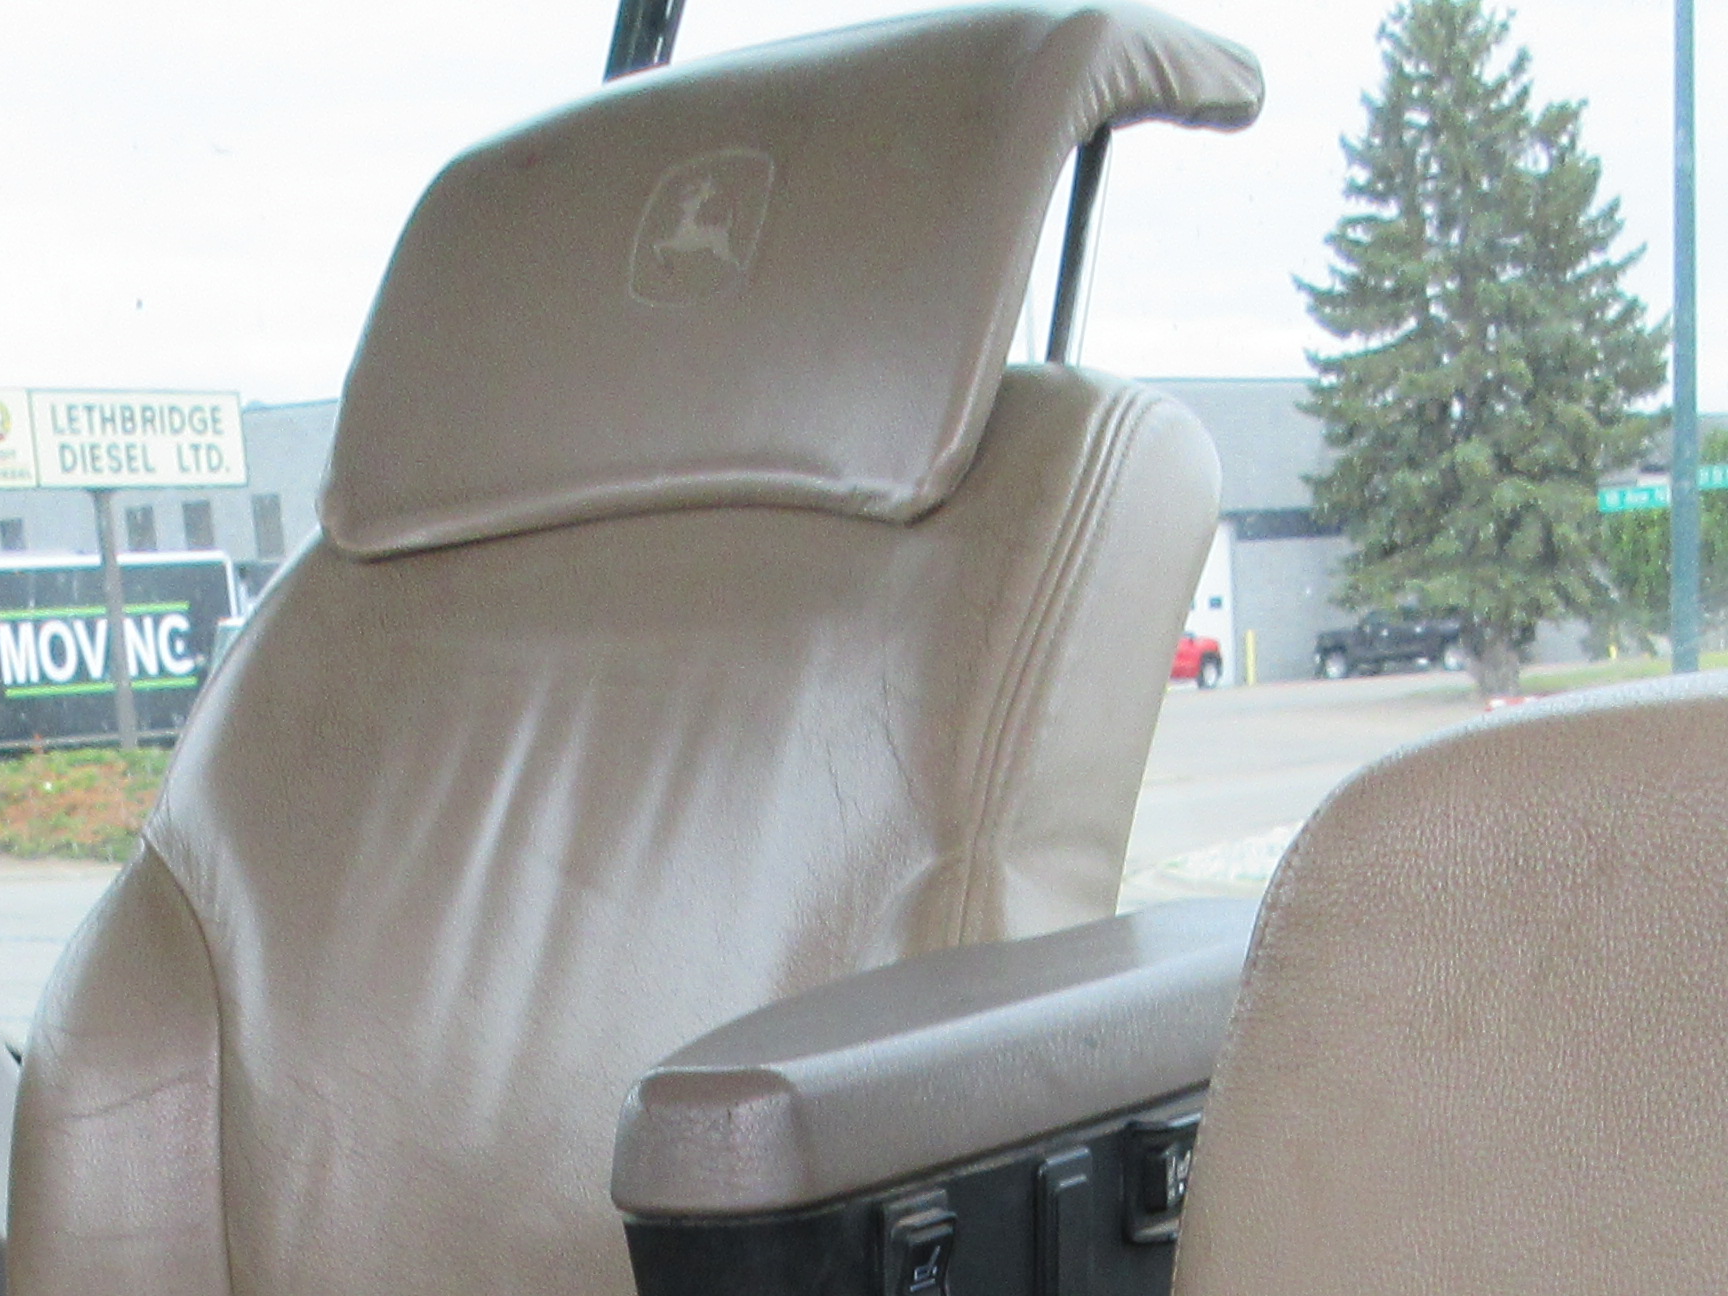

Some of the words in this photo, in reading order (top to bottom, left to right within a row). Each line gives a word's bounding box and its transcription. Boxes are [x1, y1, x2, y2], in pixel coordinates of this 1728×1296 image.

[51, 404, 224, 435] LETHBRIDGE
[58, 444, 156, 475] DIESEL
[177, 445, 231, 474] LTD.
